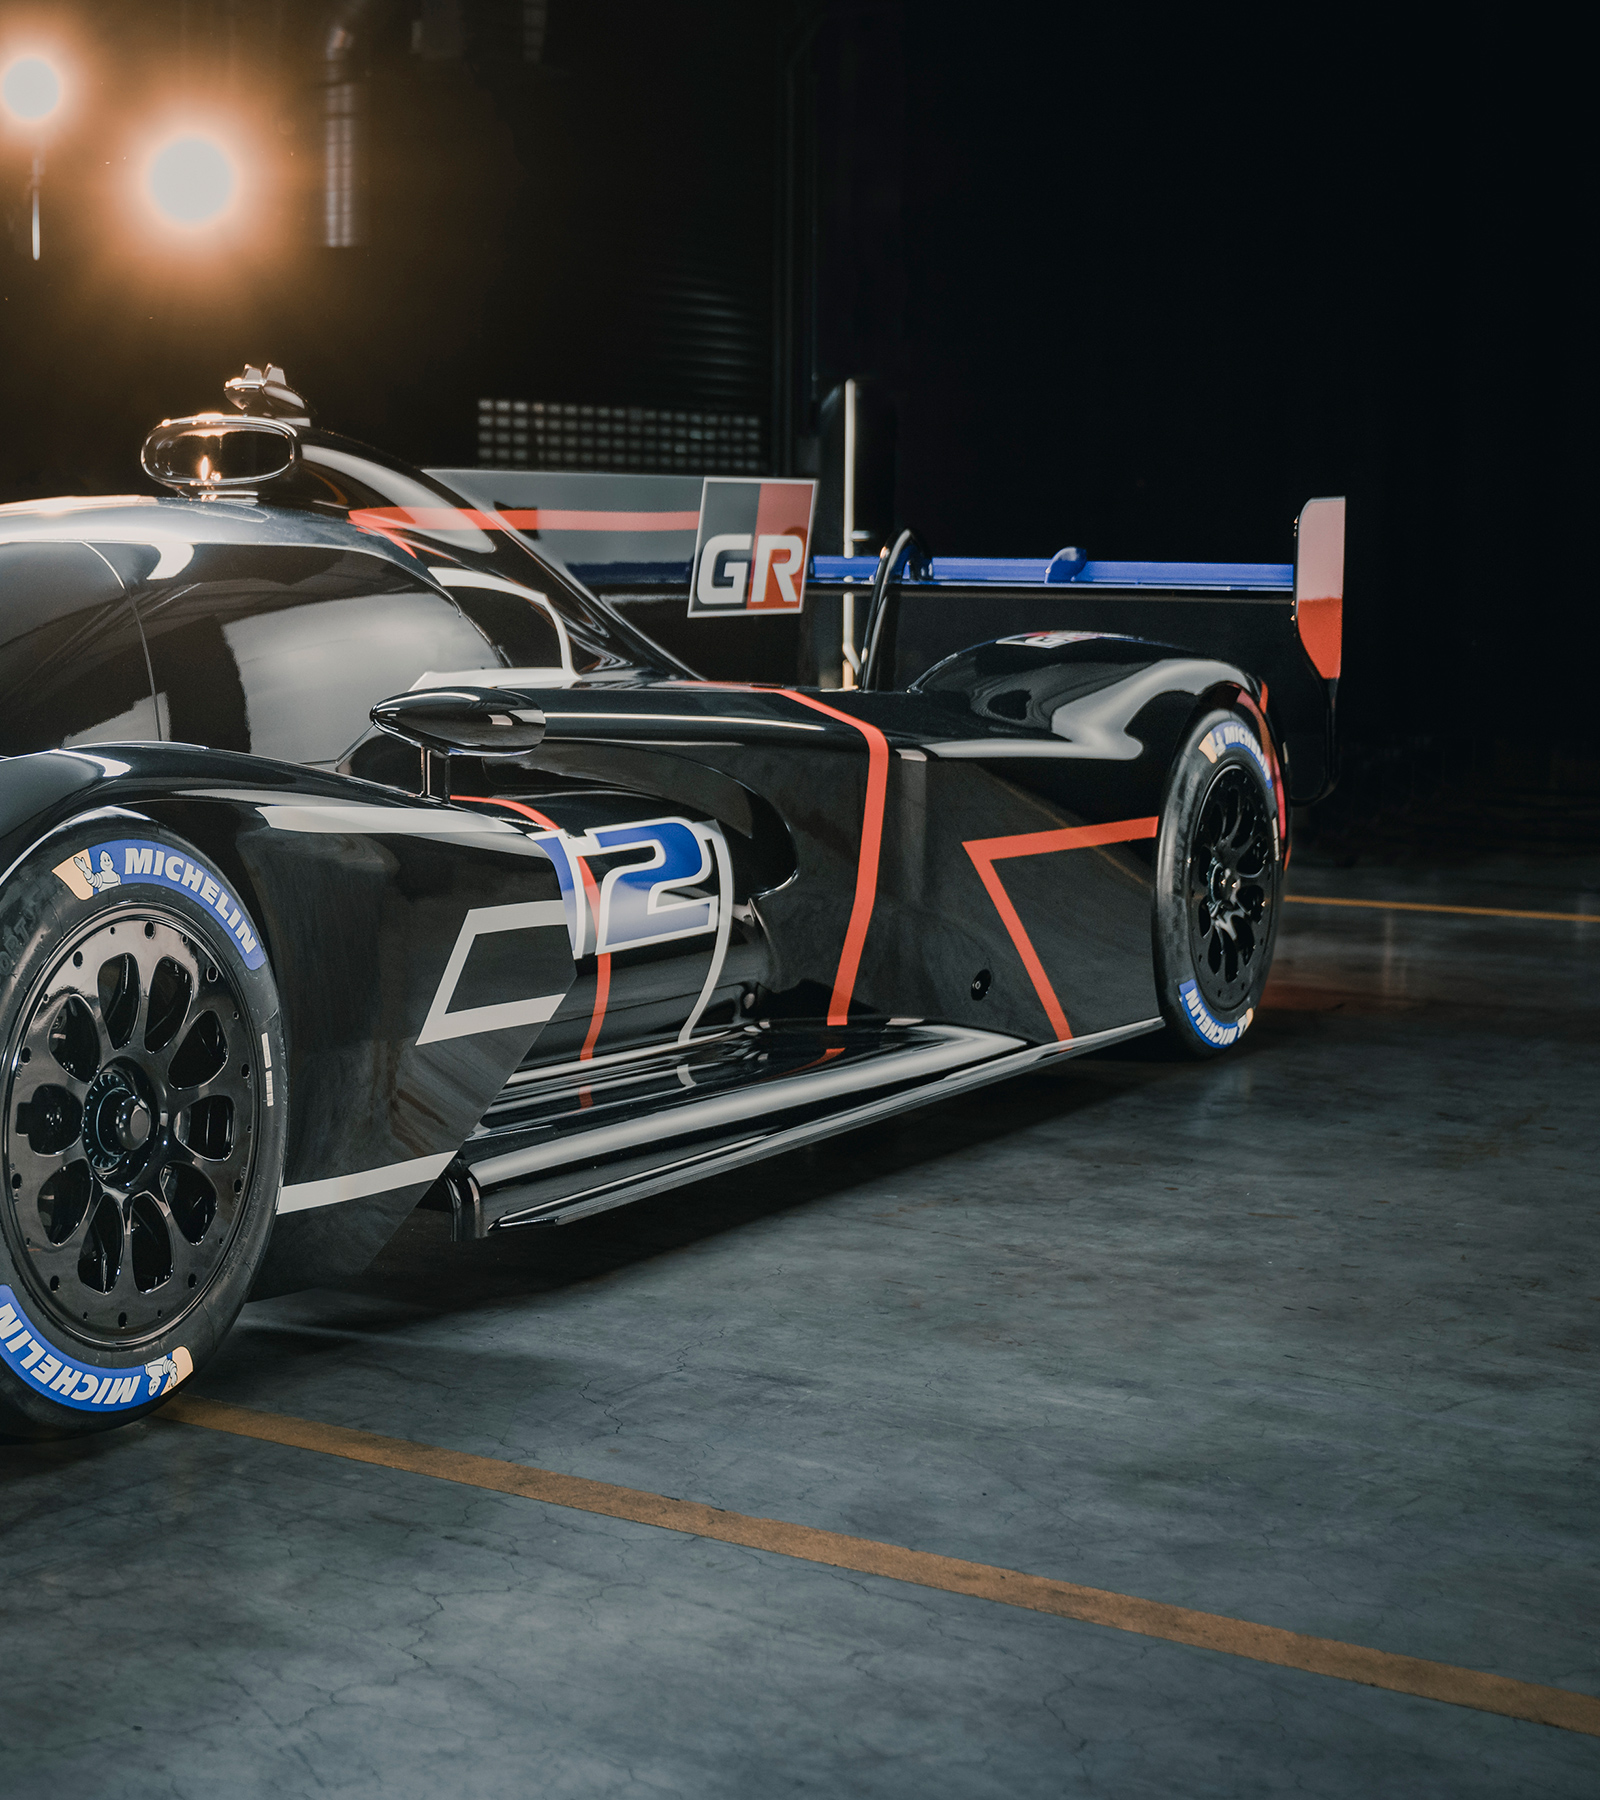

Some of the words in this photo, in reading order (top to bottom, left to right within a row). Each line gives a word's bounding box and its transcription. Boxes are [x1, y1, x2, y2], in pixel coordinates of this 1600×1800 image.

[697, 533, 803, 604] GR
[1223, 725, 1271, 780] MICHELIN
[124, 848, 258, 953] MICHELIN
[1185, 988, 1238, 1045] MICHELIN
